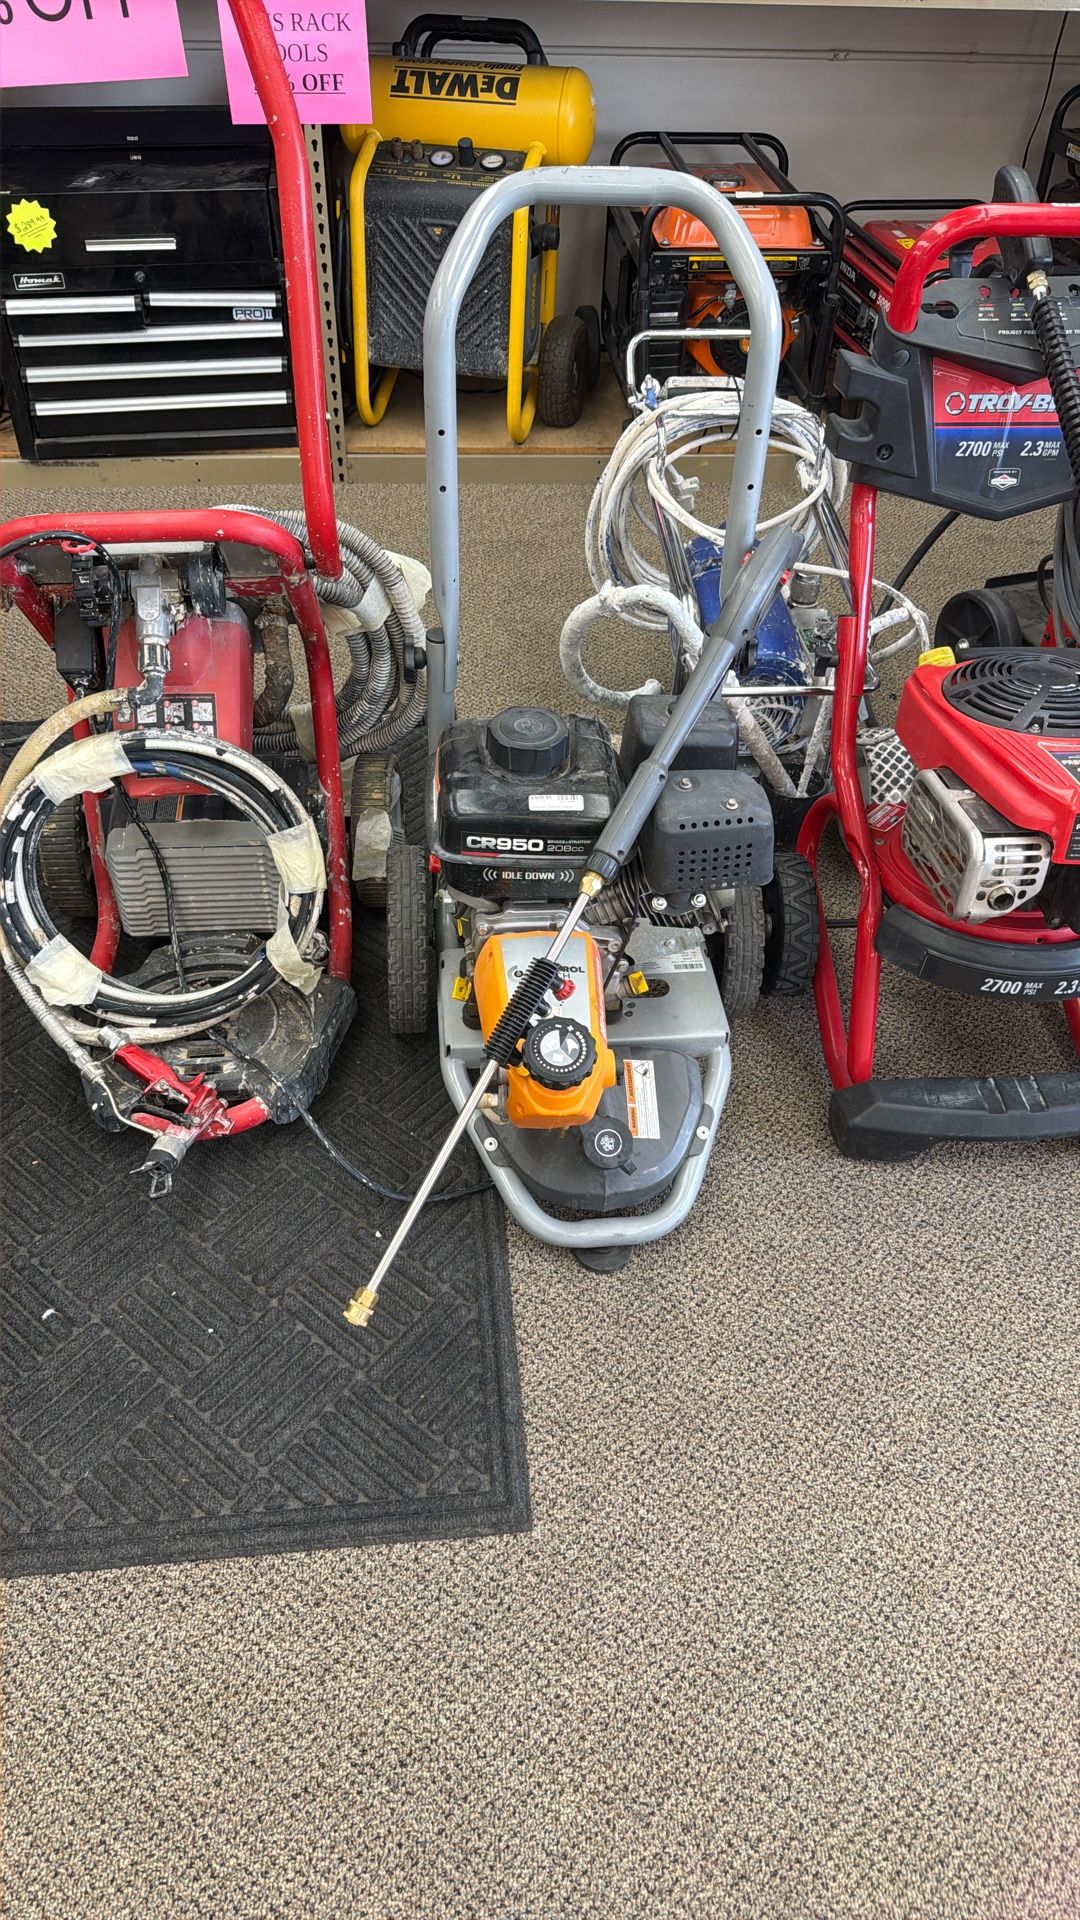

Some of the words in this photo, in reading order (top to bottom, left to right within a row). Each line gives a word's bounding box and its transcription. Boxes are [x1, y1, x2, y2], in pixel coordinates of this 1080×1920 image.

[291, 12, 352, 32] RACK
[275, 43, 328, 63] OOLS
[302, 73, 344, 92] OFF
[20, 275, 62, 285] Homak
[233, 308, 265, 321] PRO
[968, 394, 1057, 413] TROY-BI
[955, 441, 992, 457] 2700
[1020, 441, 1044, 457] 2.3
[1044, 441, 1061, 449] MAX
[1042, 449, 1060, 457] GPM
[466, 835, 544, 852] CR950
[546, 844, 585, 853] 208cc
[502, 871, 523, 880] IDLE
[525, 872, 555, 880] DOWN
[980, 978, 1023, 995] 2700
[1054, 979, 1079, 995] 2.3
